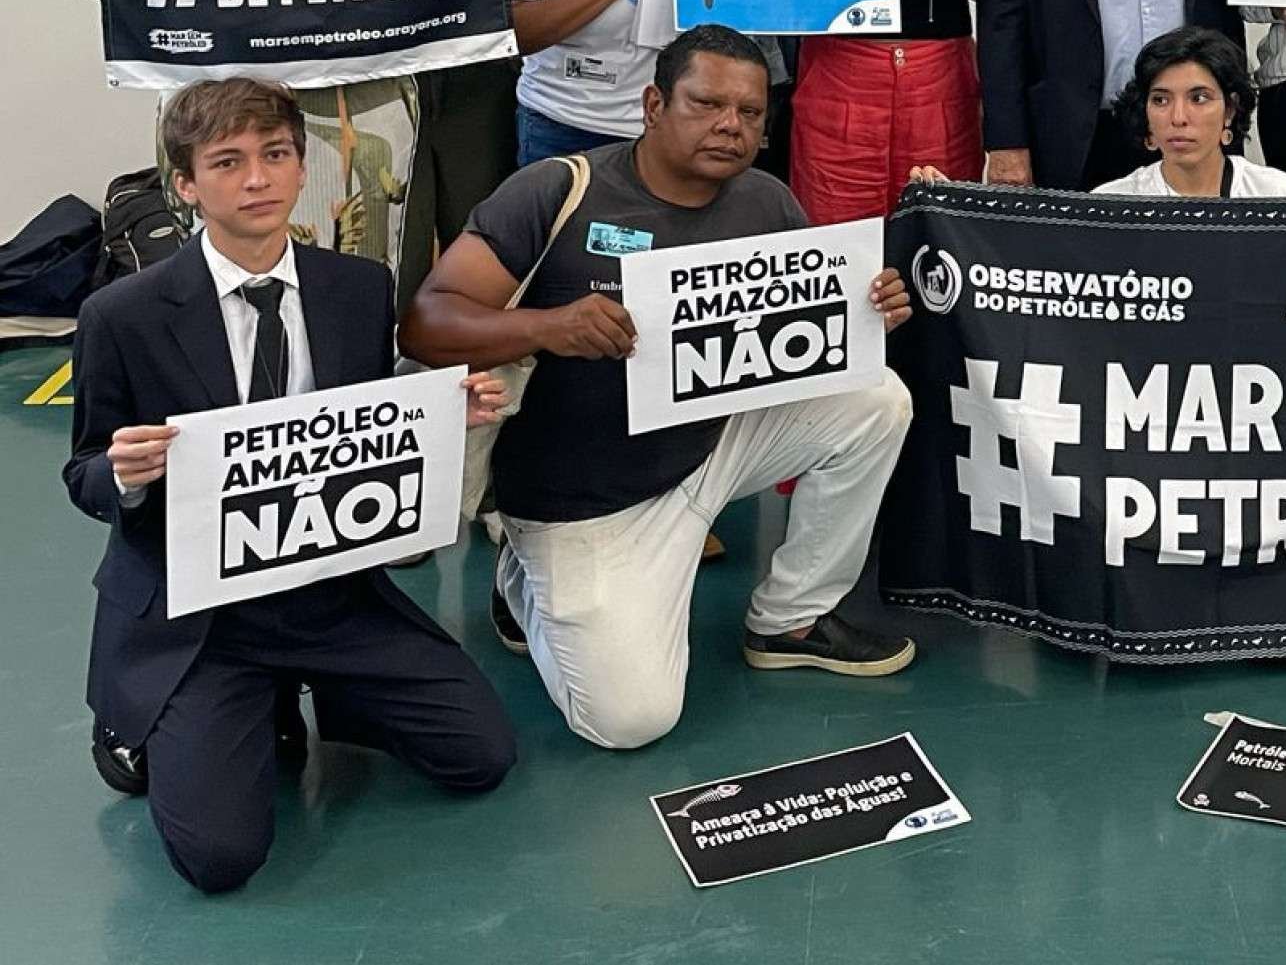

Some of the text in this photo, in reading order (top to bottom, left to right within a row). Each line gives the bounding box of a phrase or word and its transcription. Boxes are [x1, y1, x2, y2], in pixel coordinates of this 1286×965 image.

[250, 11, 467, 48] marsempetroleo.arayara.org
[671, 249, 848, 294] PETRÓLEO NA
[672, 274, 844, 325] AMAZÔNIA
[968, 264, 1194, 300] OBSERVATÓRIO
[975, 292, 1004, 311] DO
[1123, 303, 1137, 321] E
[1140, 301, 1186, 322] GÁS
[676, 314, 845, 395] NÃO!
[224, 401, 425, 458] PETRÓLEO NA
[1105, 362, 1284, 454] MAR
[222, 429, 420, 492] AMAZÔNIA
[225, 472, 421, 570] NÃO!
[1227, 752, 1286, 773] Mortais
[691, 807, 764, 835] Ameaça
[776, 793, 824, 813] Vida:
[824, 774, 899, 802] Poluição
[900, 770, 914, 783] e
[695, 786, 907, 850] Privatização das Águas!
